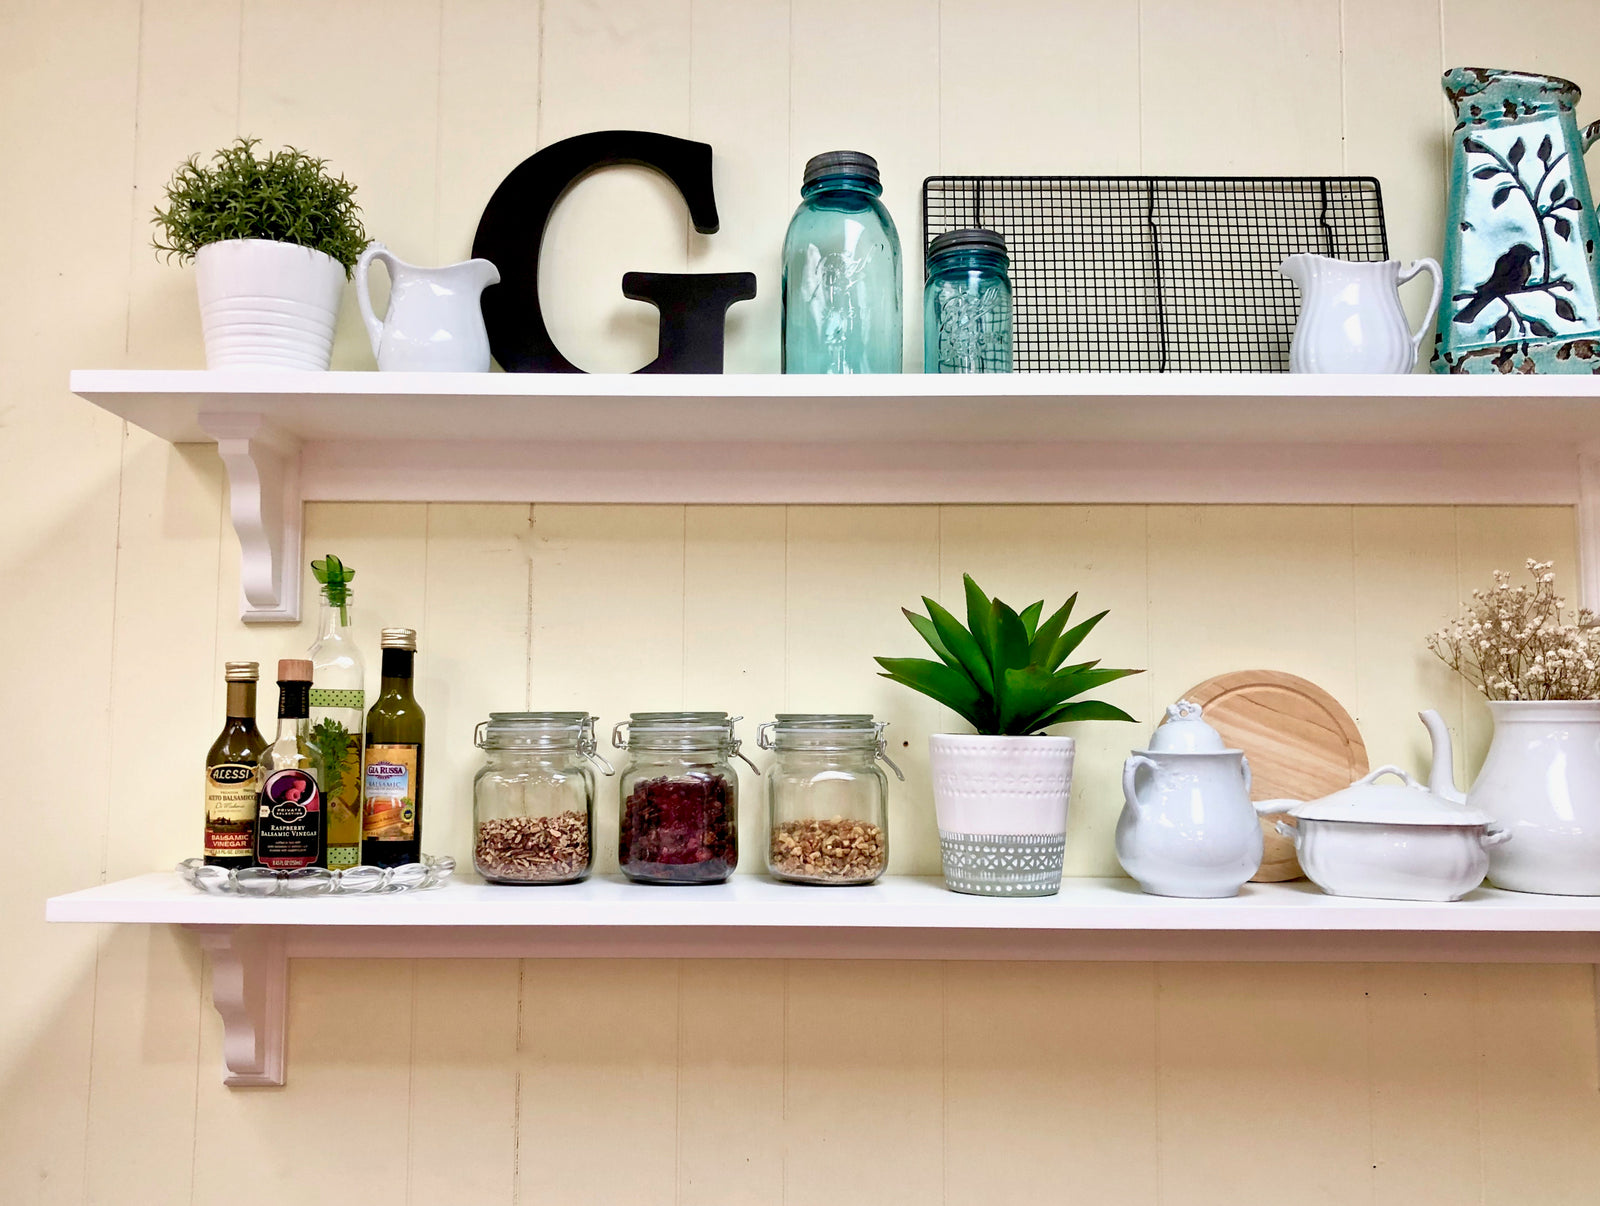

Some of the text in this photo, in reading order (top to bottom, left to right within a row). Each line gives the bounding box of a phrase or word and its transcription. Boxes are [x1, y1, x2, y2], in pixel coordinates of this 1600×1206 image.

[213, 769, 250, 779] ALESSI
[368, 766, 403, 774] GIA RUSSA
